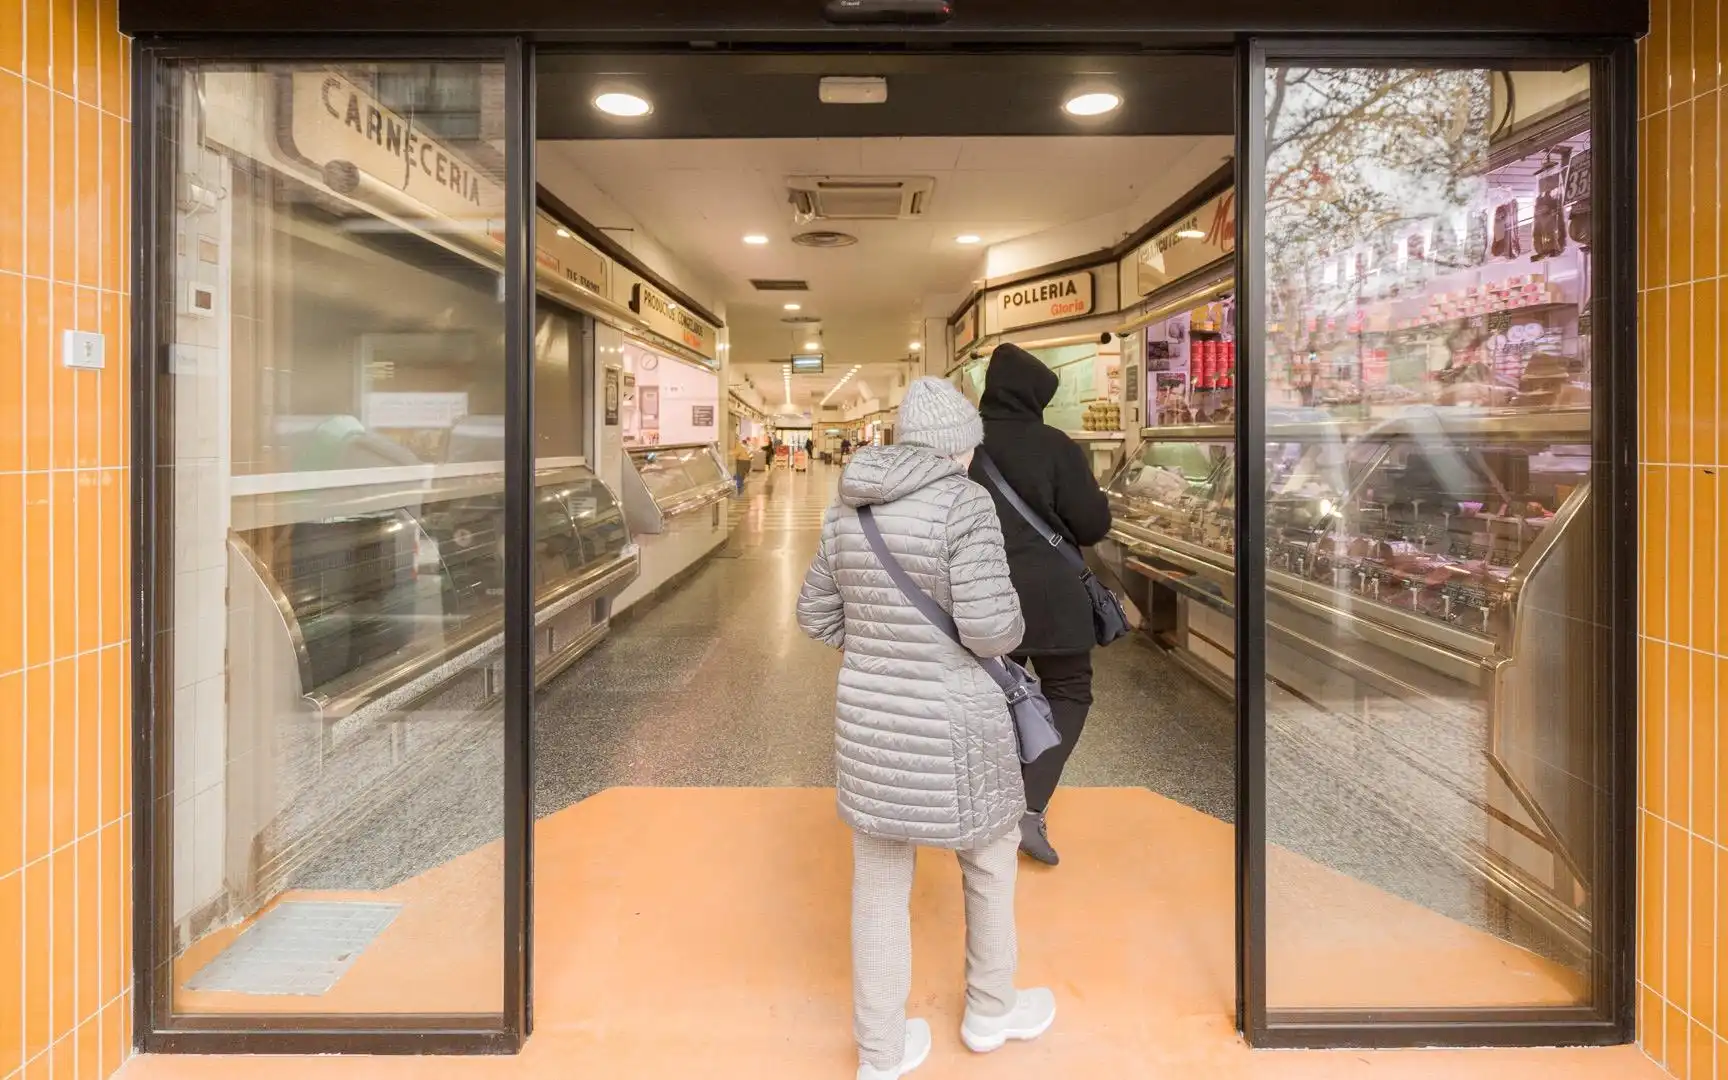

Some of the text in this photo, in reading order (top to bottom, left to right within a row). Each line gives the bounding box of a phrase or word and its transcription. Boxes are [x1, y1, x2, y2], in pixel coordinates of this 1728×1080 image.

[321, 76, 480, 206] CARNECERIA
[1003, 279, 1078, 309] POLLERIA
[1050, 300, 1086, 316] Gloria
